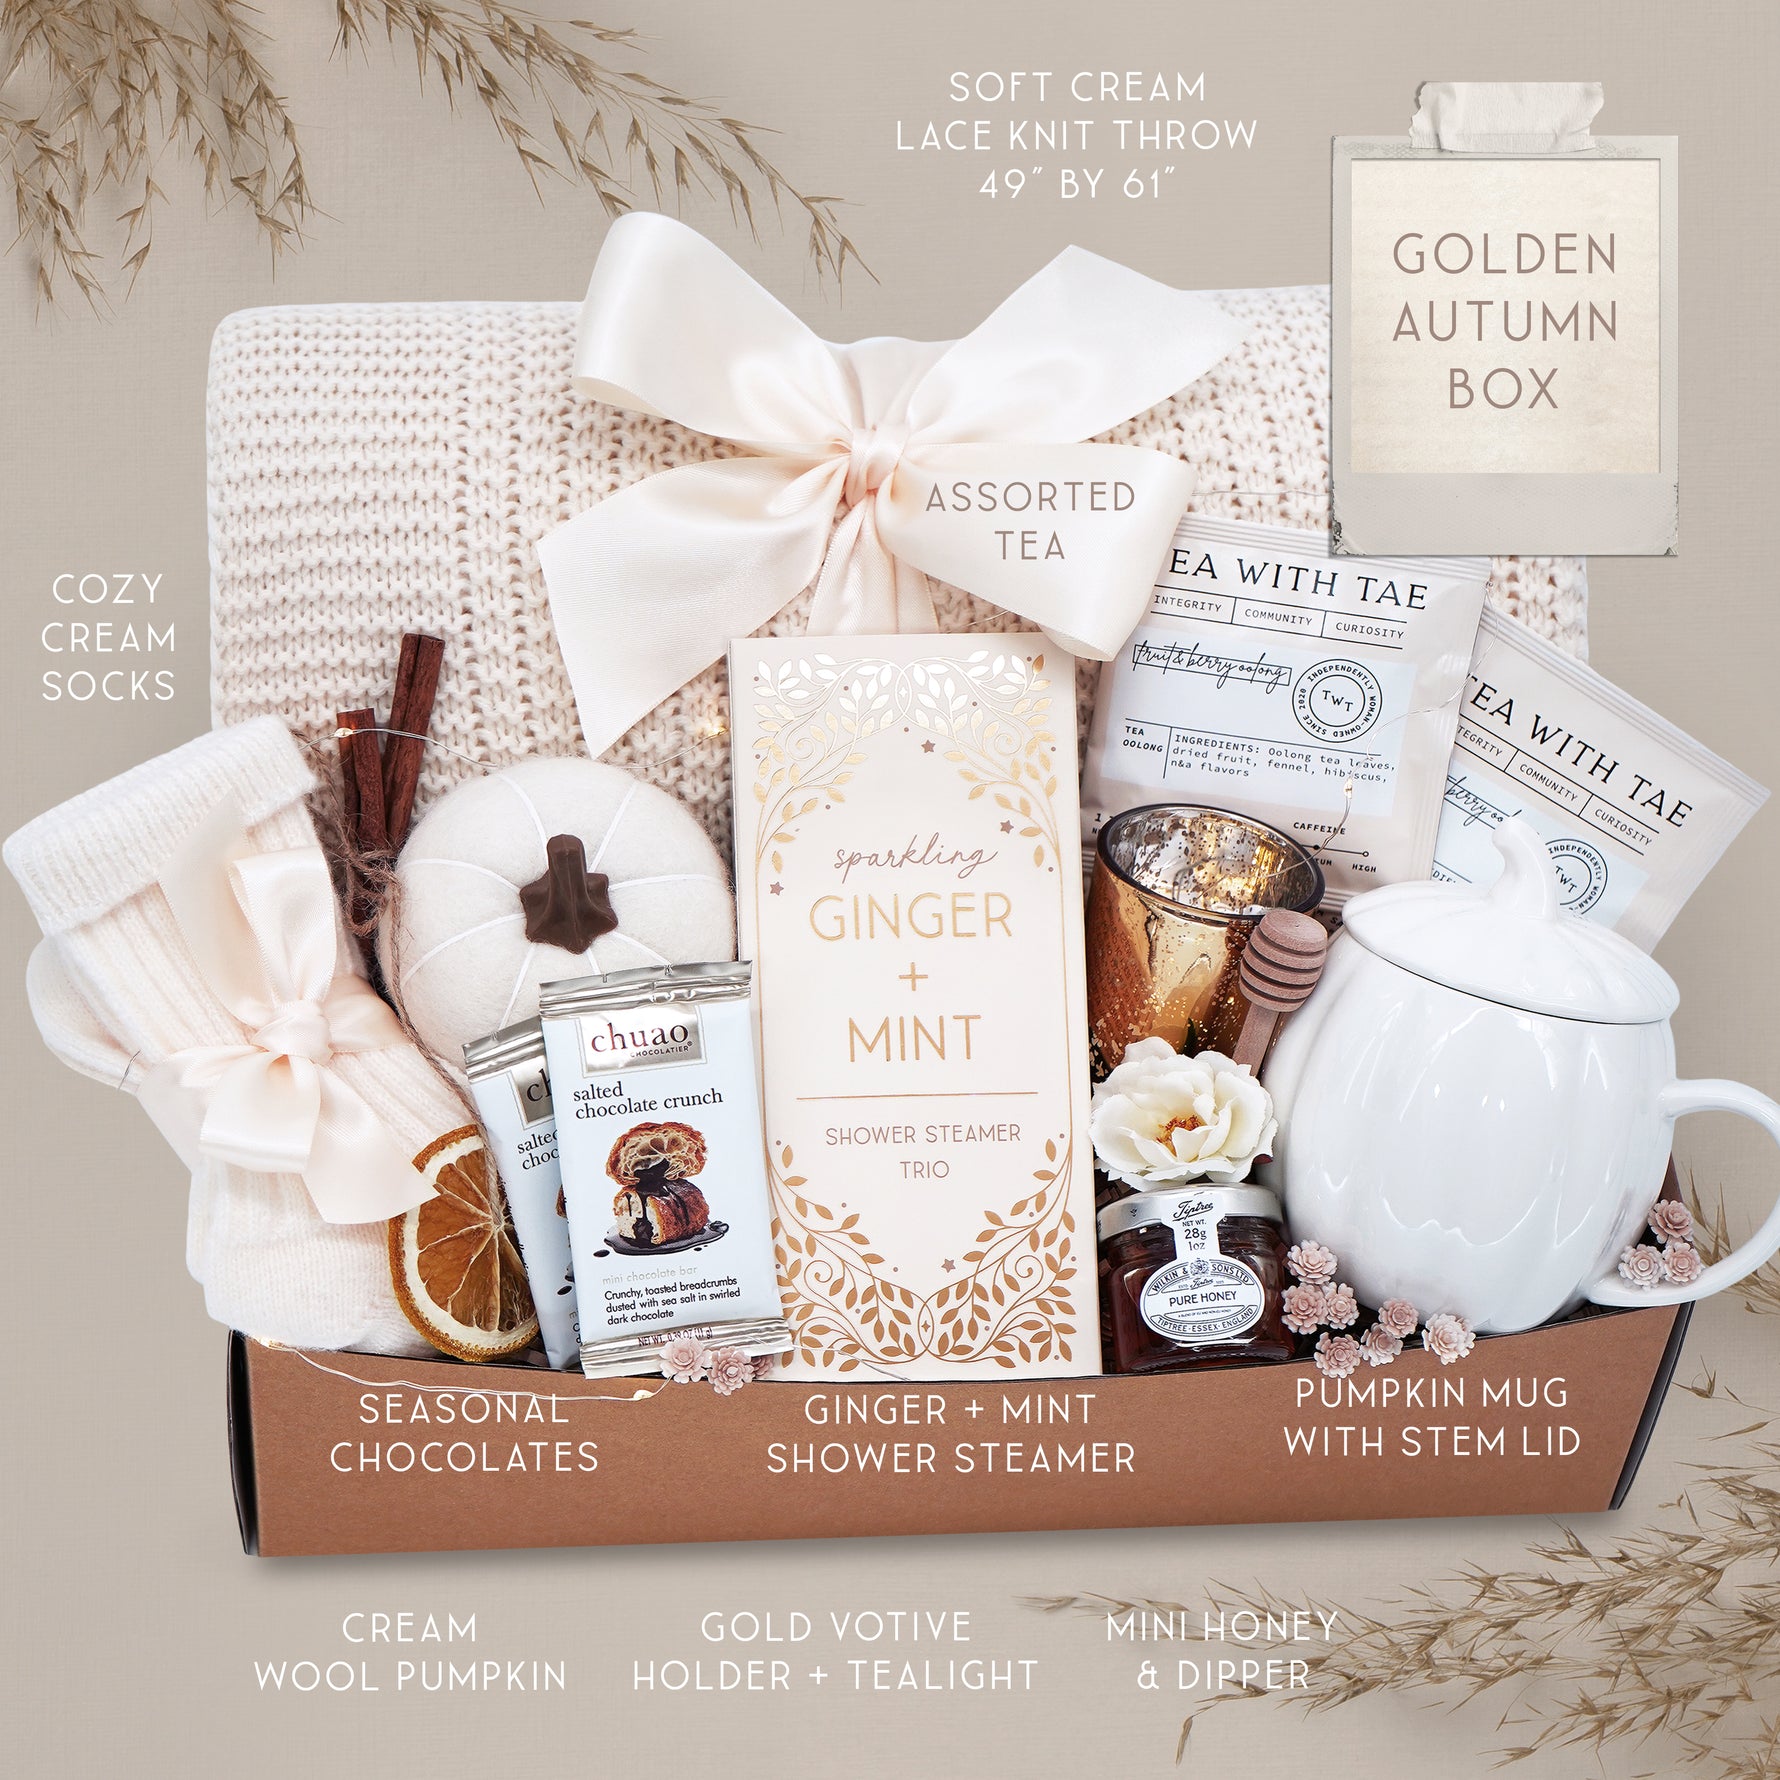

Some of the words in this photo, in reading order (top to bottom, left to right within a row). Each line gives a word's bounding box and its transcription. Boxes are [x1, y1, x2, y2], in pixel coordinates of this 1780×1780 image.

[1168, 548, 1218, 580] EA
[1236, 558, 1339, 597] WITH
[1356, 575, 1429, 611] TAE
[1153, 594, 1223, 613] INTEGRITY
[1244, 607, 1313, 627] COMMUNITY
[1334, 621, 1405, 640] CURIOSITY
[1306, 664, 1375, 691] INDEPENDENTLY
[1298, 688, 1307, 710] 2020
[1322, 689, 1354, 712] TWT
[1302, 713, 1328, 736] SINCE
[1332, 694, 1377, 738] WOMAN-OWNED
[1125, 725, 1145, 737] TEA
[1457, 725, 1504, 757] TEGRITY
[1122, 739, 1164, 753] OOLONG
[1174, 734, 1260, 754] INGREDIENTS:
[1268, 747, 1312, 763] Oolong
[1320, 754, 1341, 765] tea
[1170, 759, 1192, 769] n&a
[1200, 762, 1250, 777] flavors
[1172, 746, 1209, 759] dried
[1216, 752, 1258, 767] fruit,
[1267, 759, 1316, 775] fennel,
[1528, 713, 1620, 785] WITH
[1627, 773, 1694, 828] TAE
[1519, 762, 1578, 803] COMMUNITY
[1293, 821, 1347, 835] CAFFEINE
[1594, 807, 1653, 847] CURIOSITY
[832, 831, 999, 884] sparkling
[1351, 863, 1378, 873] HIGH
[1554, 865, 1578, 893] TWT
[1568, 885, 1600, 911] WOMAN-
[809, 891, 1013, 942] GINGER
[898, 961, 929, 992] +
[591, 1022, 689, 1053] chuao
[848, 1014, 982, 1063] MINT
[573, 1080, 624, 1102] salted
[575, 1097, 658, 1120] chocolate
[663, 1087, 724, 1109] crunch
[825, 1125, 917, 1146] SHOWER
[925, 1123, 1022, 1144] STEAMER
[899, 1160, 950, 1179] TRIO
[1184, 1228, 1207, 1241] 28g
[1188, 1241, 1206, 1251] 1oz
[602, 1275, 623, 1286] mini
[626, 1267, 676, 1283] chocolate
[679, 1265, 698, 1276] bar
[1151, 1270, 1179, 1292] WILKIN
[1182, 1267, 1189, 1275] &
[1211, 1264, 1235, 1275] SONS
[1235, 1270, 1250, 1283] LTD
[604, 1287, 644, 1301] Crunchy,
[645, 1282, 678, 1296] toasted
[680, 1276, 738, 1291] breadcrumbs
[605, 1299, 637, 1313] dusted
[639, 1296, 659, 1309] with
[661, 1297, 677, 1306] sea
[680, 1292, 696, 1304] salt
[698, 1292, 707, 1302] in
[709, 1287, 741, 1301] swirled
[1169, 1293, 1199, 1308] PURE
[1200, 1290, 1237, 1303] HONEY
[607, 1313, 629, 1326] dark
[631, 1309, 674, 1322] chocolate
[1157, 1316, 1187, 1332] TIPTREE
[1191, 1323, 1218, 1332] ESSEX
[1222, 1307, 1254, 1329] ENGLAND
